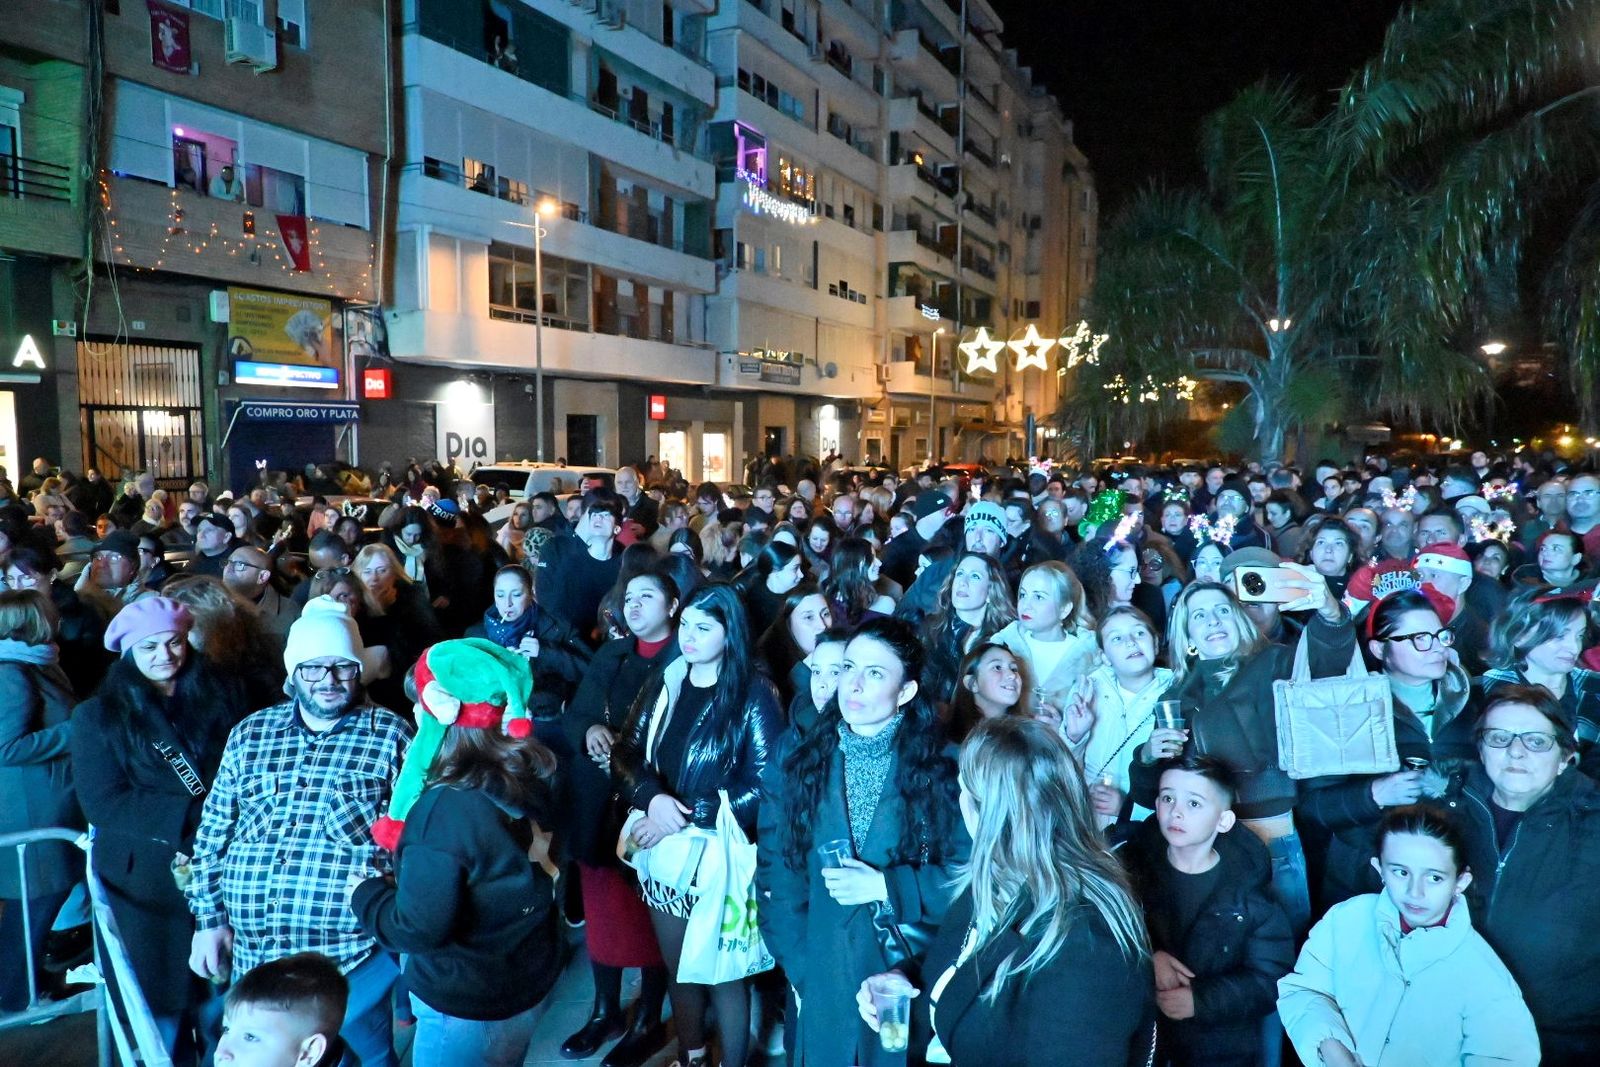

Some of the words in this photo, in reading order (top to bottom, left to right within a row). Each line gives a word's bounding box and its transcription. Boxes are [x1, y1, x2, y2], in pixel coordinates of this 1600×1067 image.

[12, 333, 46, 369] A
[246, 407, 294, 418] COMPRO
[296, 408, 318, 418] ORO
[320, 409, 327, 418] Y
[329, 409, 359, 419] PLATA
[1381, 570, 1411, 583] FELIZ
